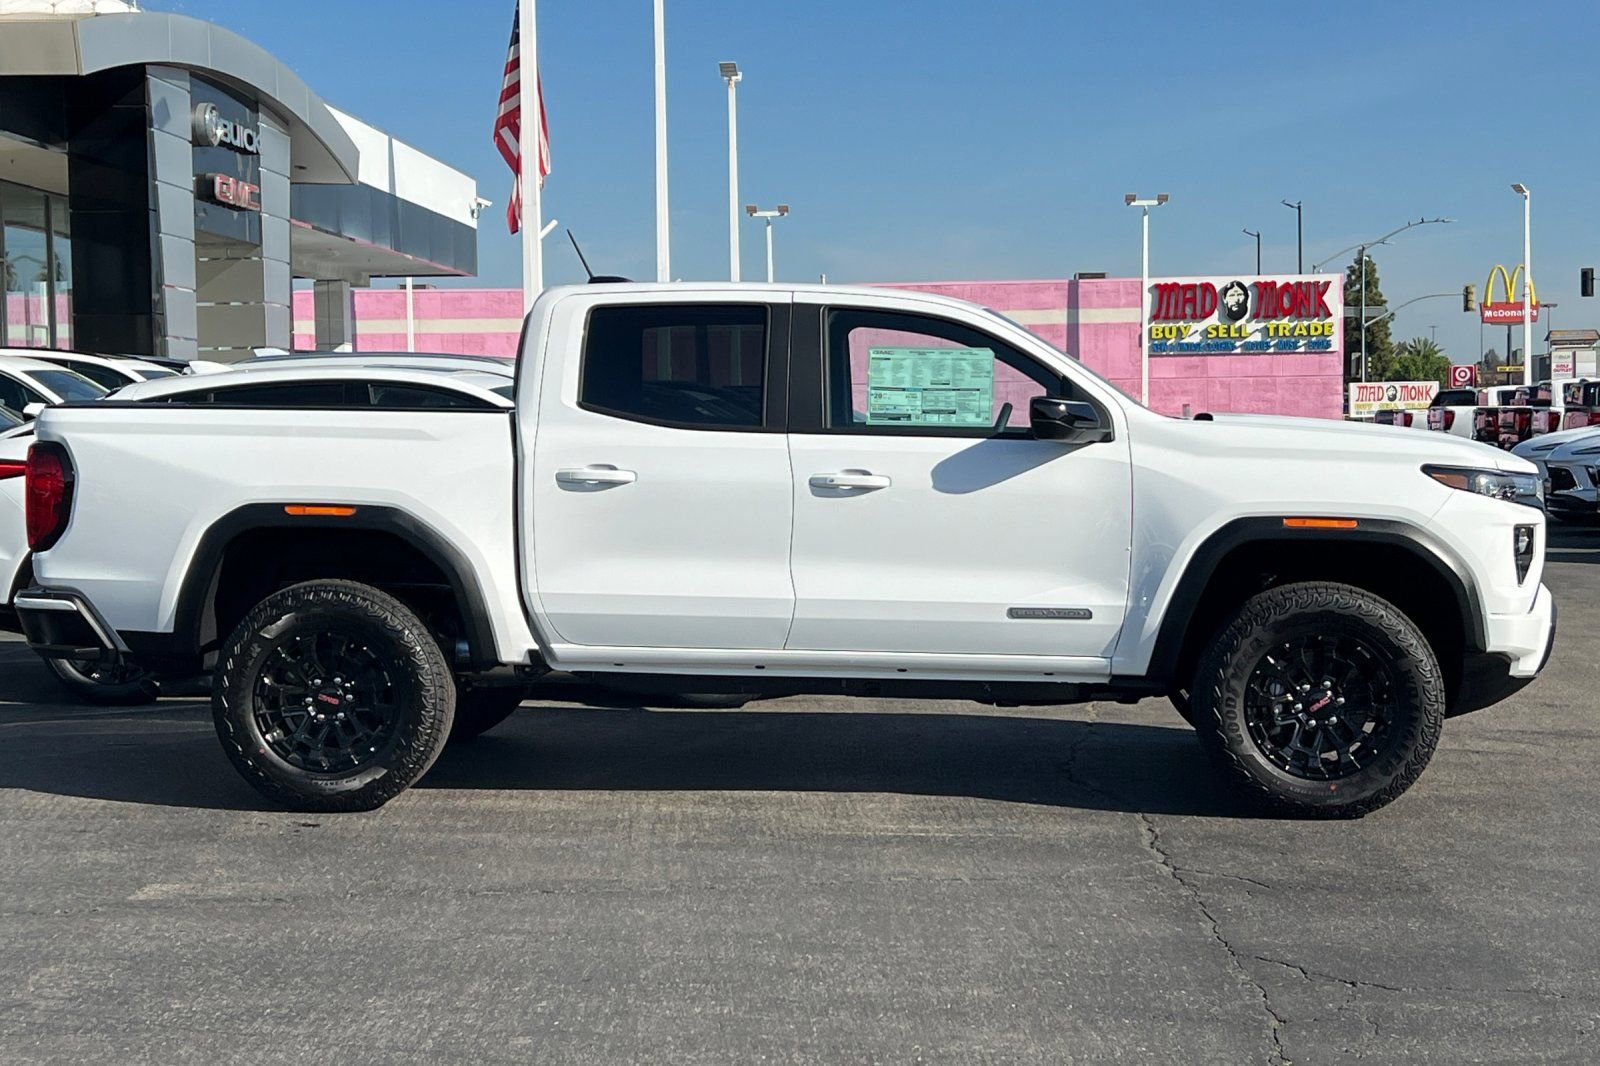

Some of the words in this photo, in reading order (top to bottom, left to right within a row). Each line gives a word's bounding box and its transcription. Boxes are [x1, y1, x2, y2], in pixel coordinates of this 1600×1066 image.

[217, 119, 261, 155] BUICK
[215, 174, 261, 211] GMC
[1152, 281, 1218, 320] MAD
[1252, 280, 1333, 319] MONK
[1484, 308, 1537, 318] McDonal's
[1151, 325, 1192, 340] BUY
[1207, 324, 1250, 339] SELL
[1267, 322, 1335, 337] TRADE
[1355, 385, 1384, 402] MAD
[1398, 384, 1433, 401] MONK
[1011, 608, 1089, 618] ELEVATION
